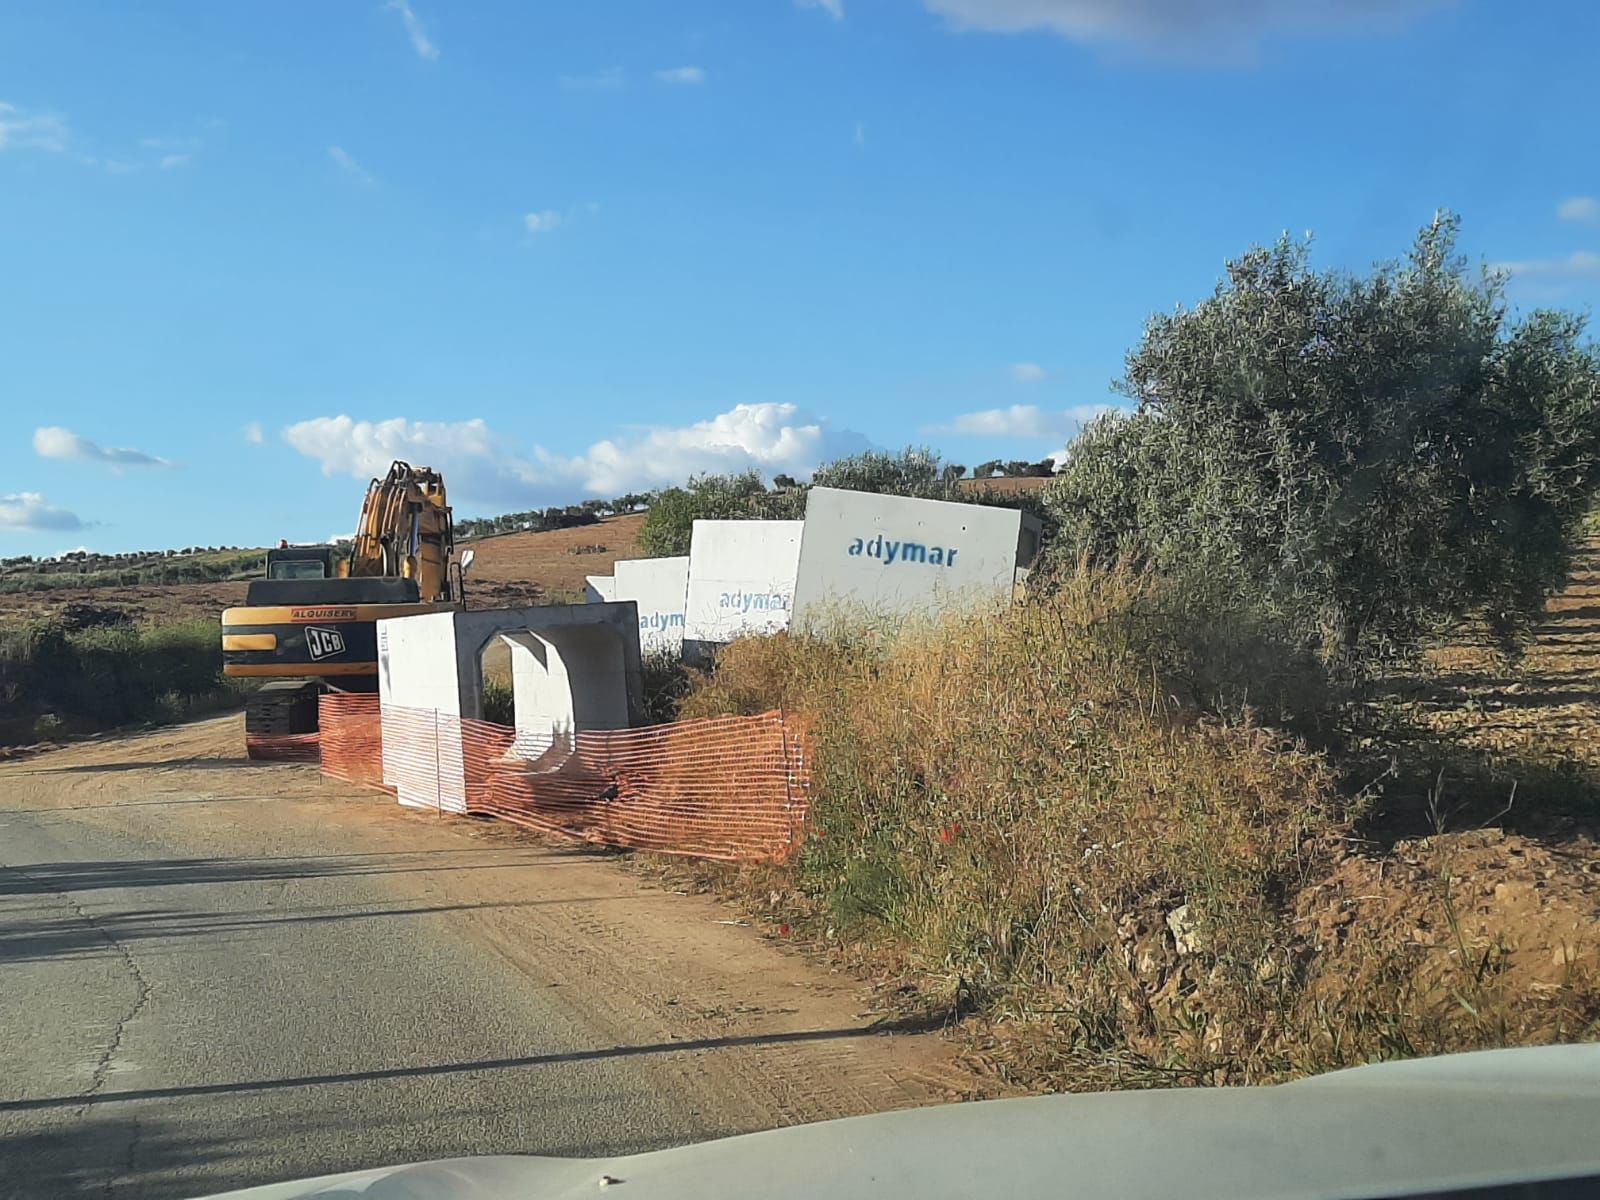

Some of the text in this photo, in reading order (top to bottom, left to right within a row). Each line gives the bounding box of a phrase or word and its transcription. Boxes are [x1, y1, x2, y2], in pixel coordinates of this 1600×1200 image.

[848, 534, 958, 567] adymar
[719, 589, 790, 613] adymar
[311, 630, 341, 656] JCB
